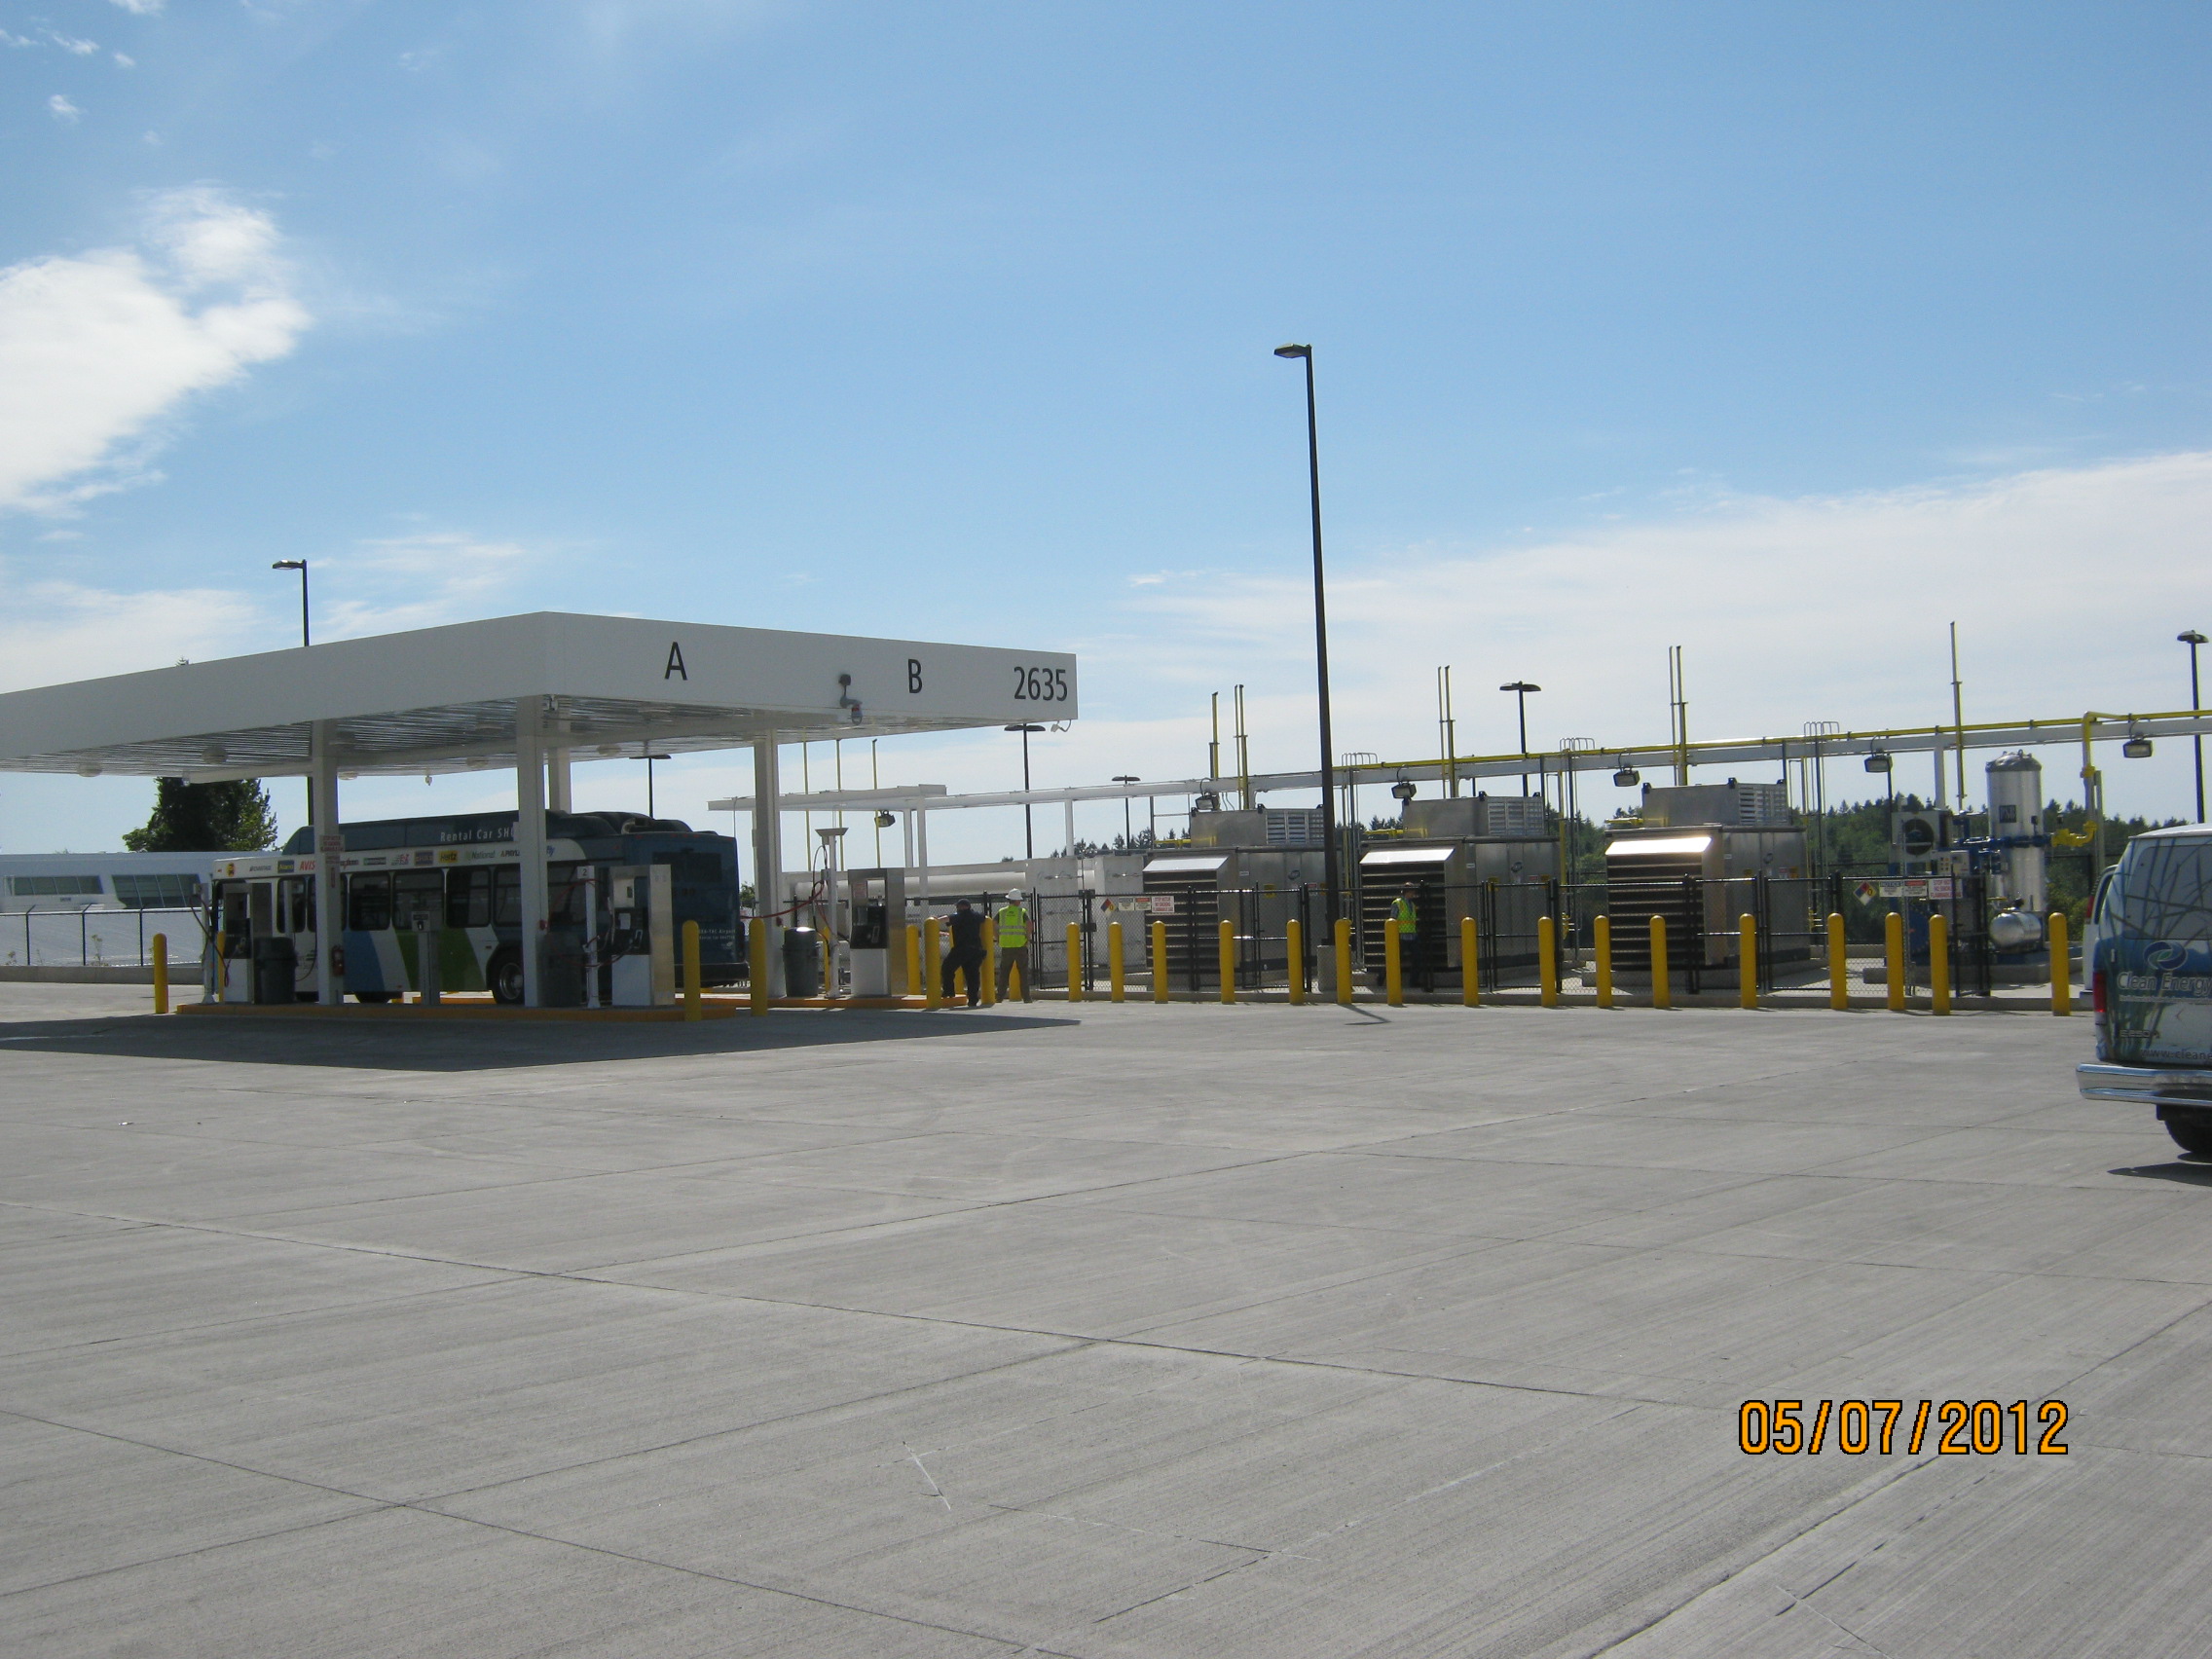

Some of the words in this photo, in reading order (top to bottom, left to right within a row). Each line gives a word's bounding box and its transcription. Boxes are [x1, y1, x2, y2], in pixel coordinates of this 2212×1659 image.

[664, 641, 687, 681] A
[907, 659, 923, 694] B
[1014, 666, 1068, 701] 2635
[440, 831, 472, 842] Rental
[477, 830, 493, 839] Car
[299, 860, 315, 870] AVIS
[2118, 971, 2157, 990] Clean
[2161, 973, 2212, 996] Energy
